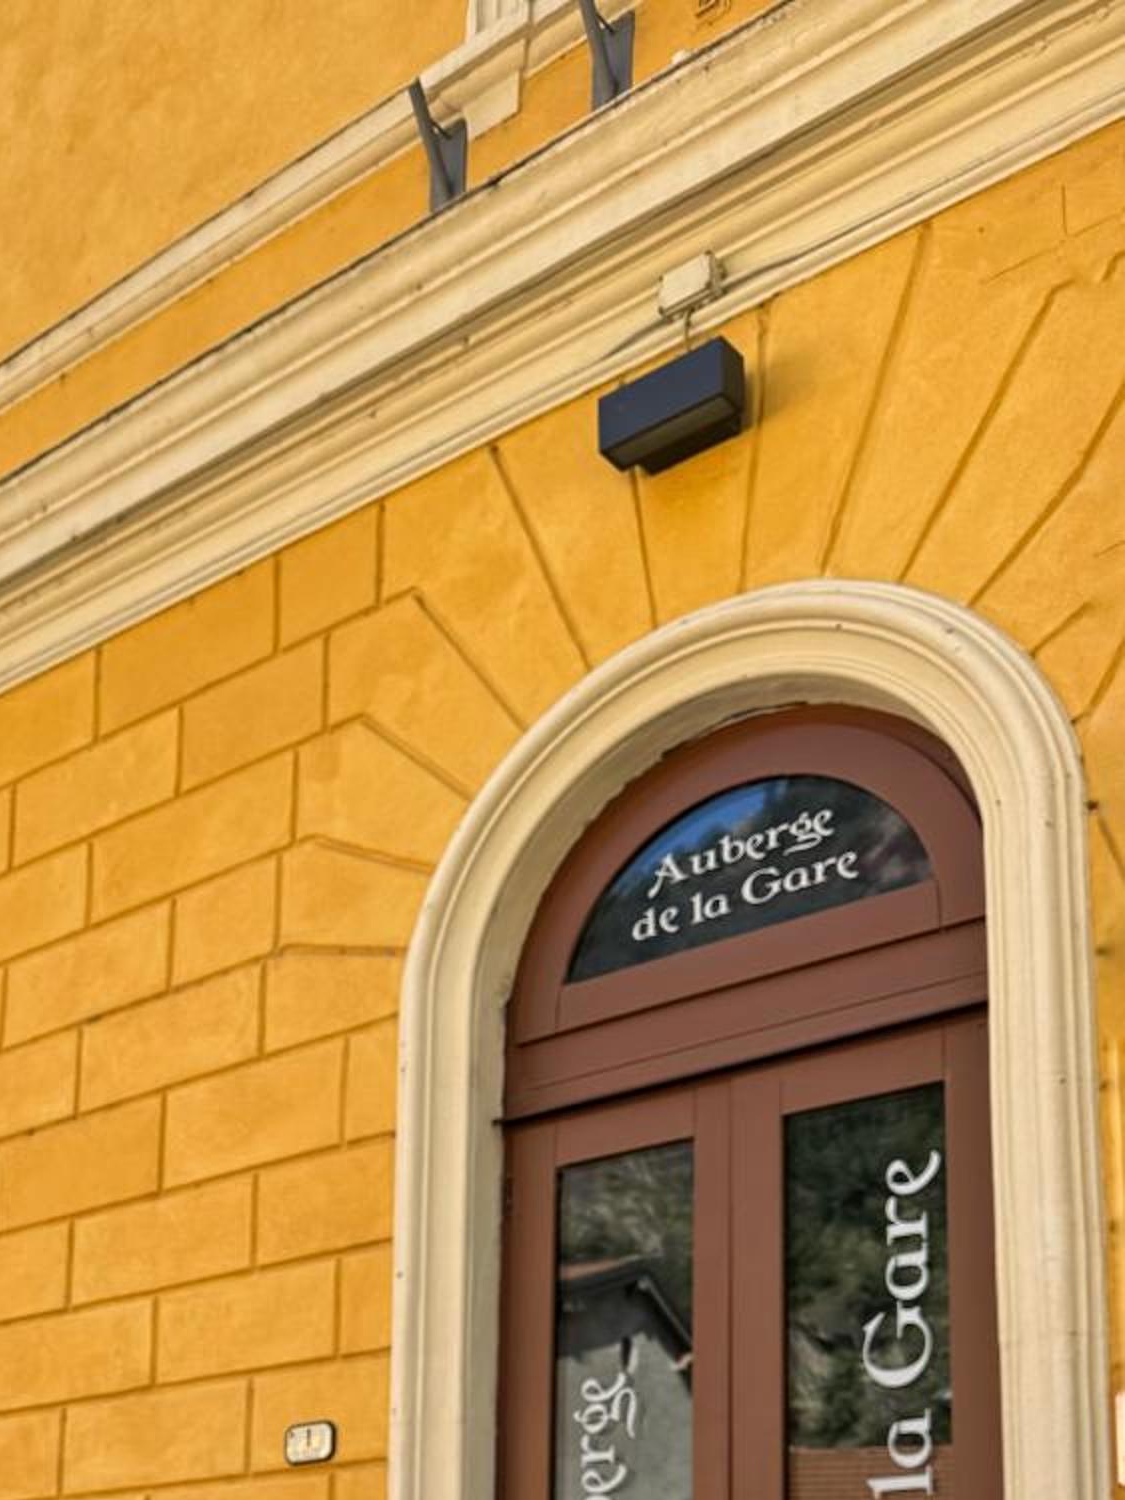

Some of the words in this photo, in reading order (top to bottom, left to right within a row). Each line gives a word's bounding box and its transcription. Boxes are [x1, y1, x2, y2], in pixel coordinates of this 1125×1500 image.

[631, 906, 679, 941] de
[691, 893, 731, 924] la
[741, 851, 859, 904] Gare
[647, 809, 835, 898] Auberge
[863, 1149, 941, 1388] Gare
[866, 1409, 933, 1499] la
